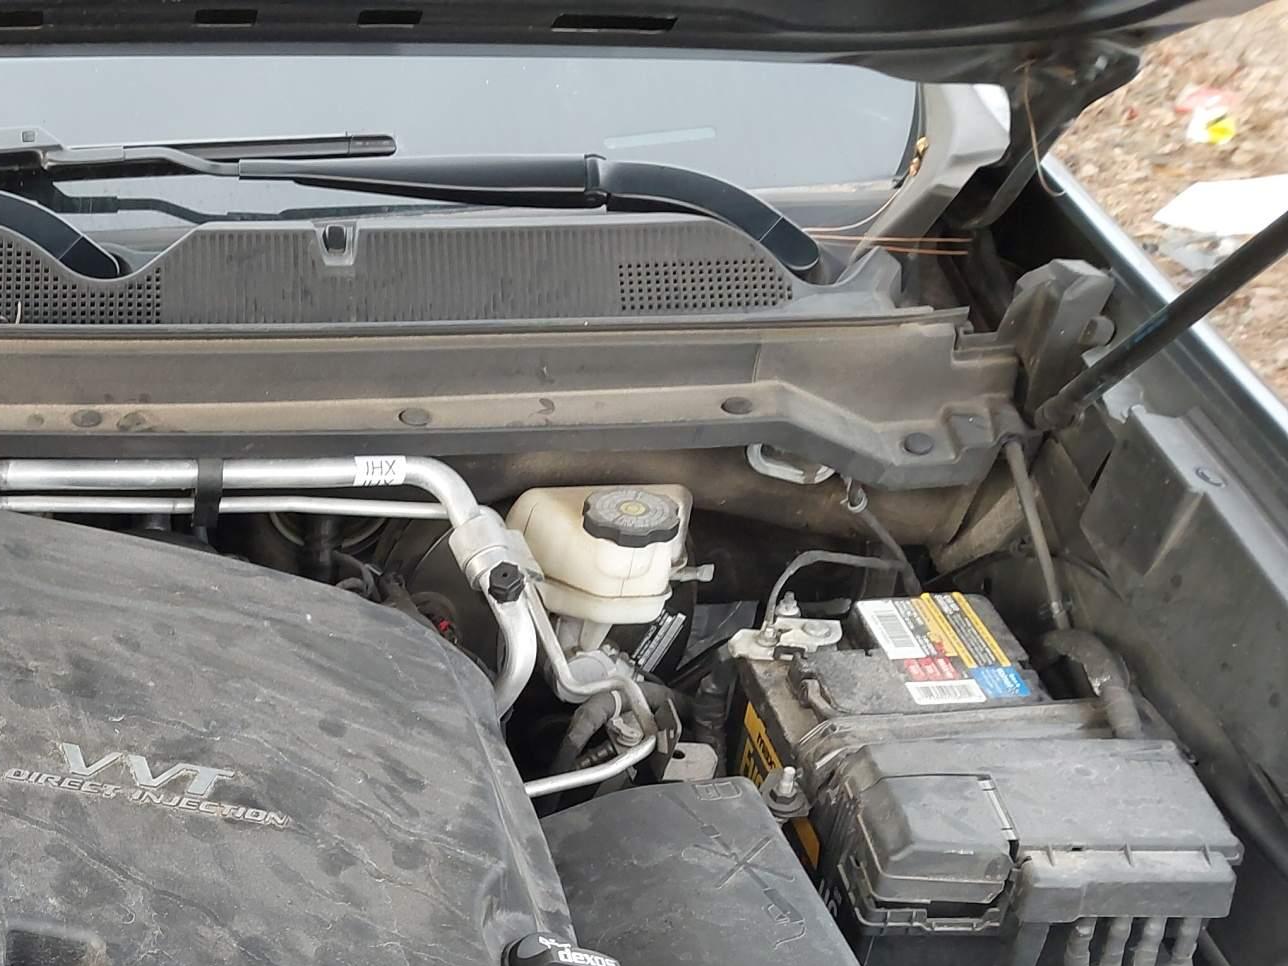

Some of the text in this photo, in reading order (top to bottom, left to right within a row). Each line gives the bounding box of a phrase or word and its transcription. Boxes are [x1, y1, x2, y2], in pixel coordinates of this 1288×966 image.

[4, 768, 289, 827] DIRECT INJECTION
[60, 742, 235, 797] VVT
